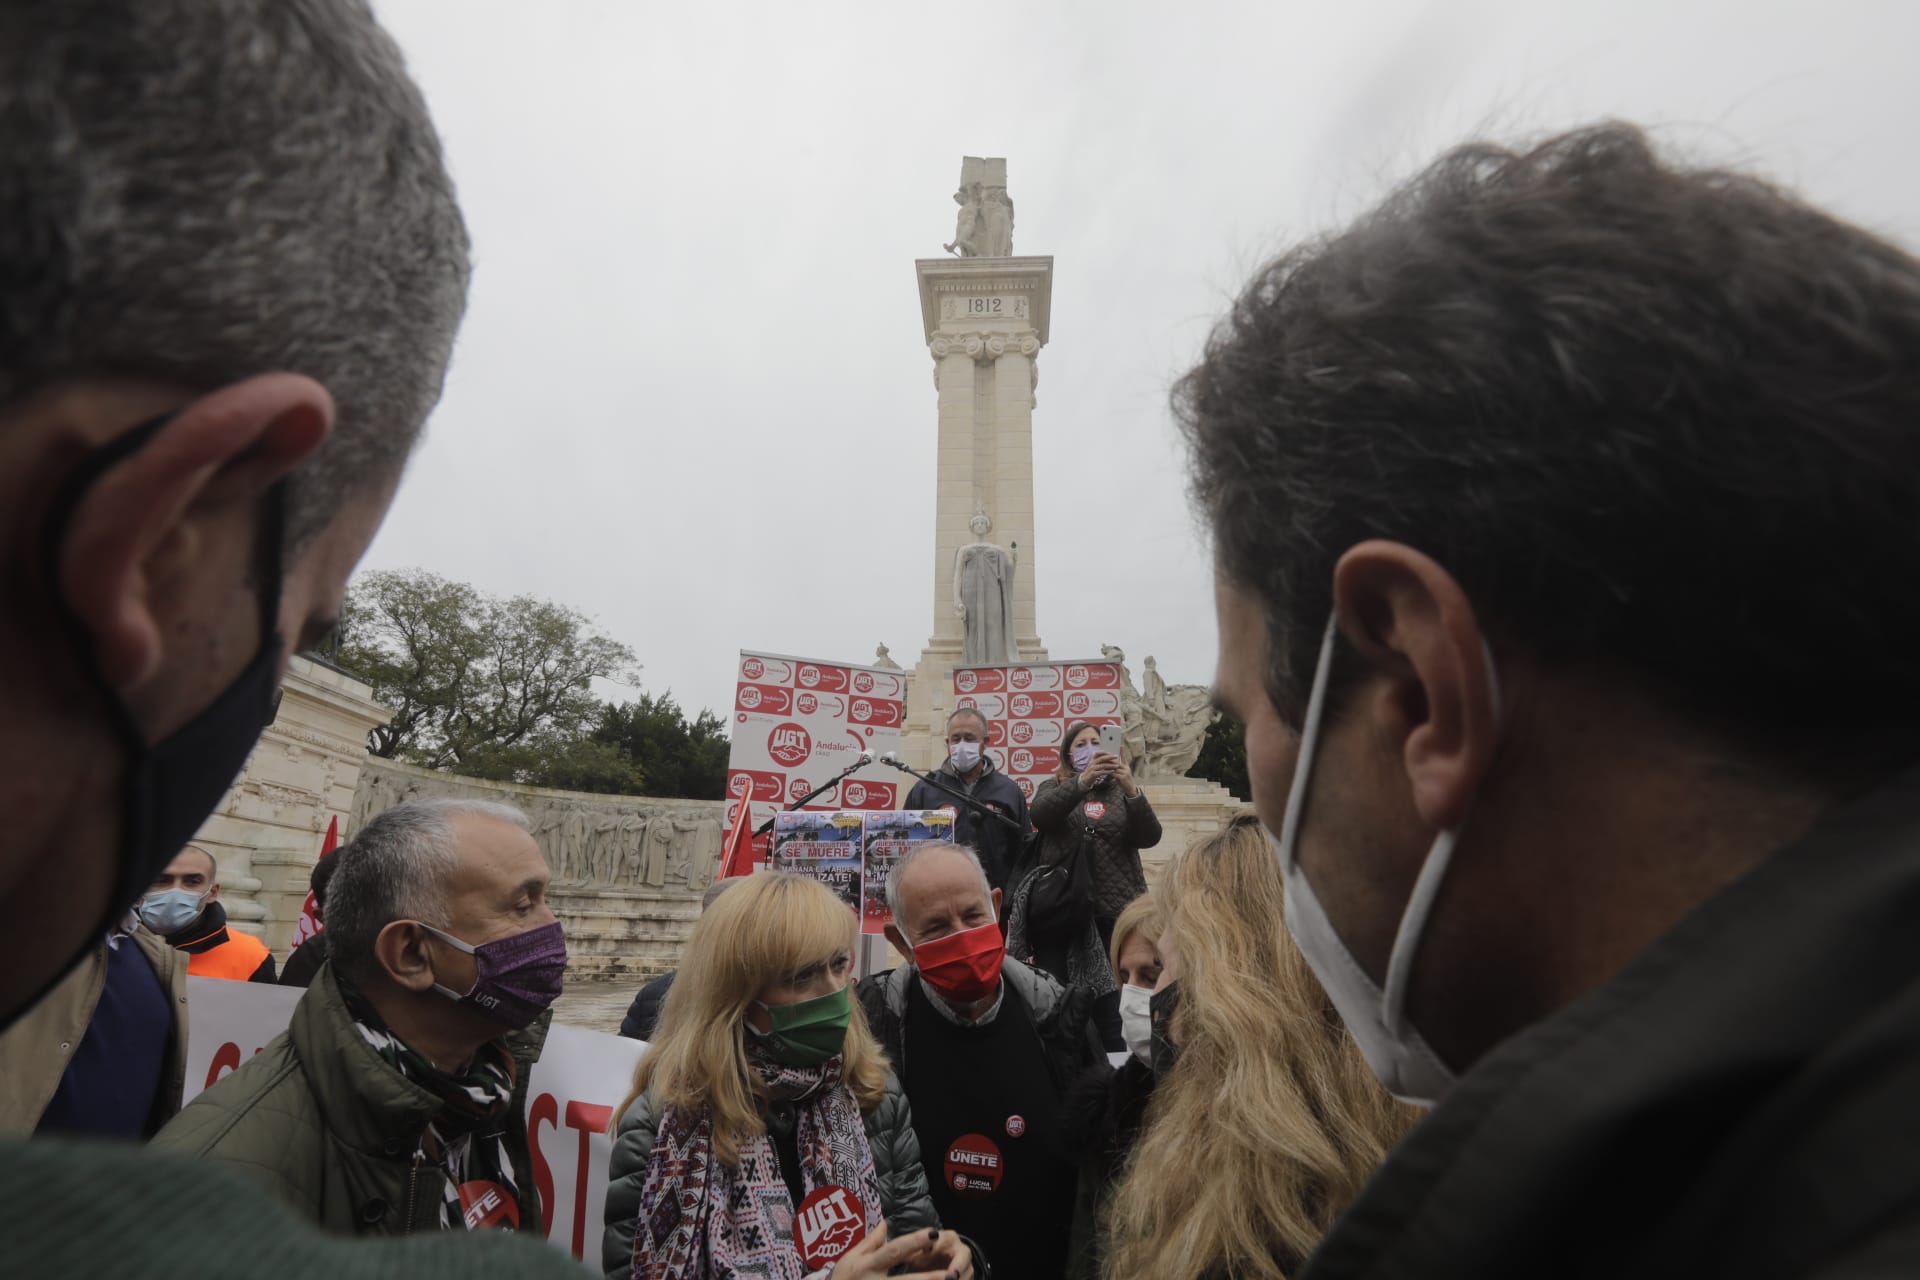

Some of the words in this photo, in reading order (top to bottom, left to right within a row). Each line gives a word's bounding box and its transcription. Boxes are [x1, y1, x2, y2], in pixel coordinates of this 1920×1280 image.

[968, 298, 1002, 313] 1812
[801, 668, 818, 678] UGT
[742, 689, 758, 699] UGT
[799, 696, 816, 706] UGT
[854, 703, 871, 713] UGT
[1014, 725, 1031, 735] UGT
[774, 729, 807, 748] UGT
[1014, 753, 1031, 763] UGT
[792, 782, 809, 792] UGT
[849, 787, 865, 797] UGT
[785, 848, 801, 857] SE
[807, 848, 850, 857] MUERE
[876, 846, 892, 857] SE
[474, 992, 501, 1009] UGT
[950, 1149, 998, 1168] ÚNETE
[969, 1179, 990, 1187] LUCHA
[798, 1188, 853, 1244] UGT
